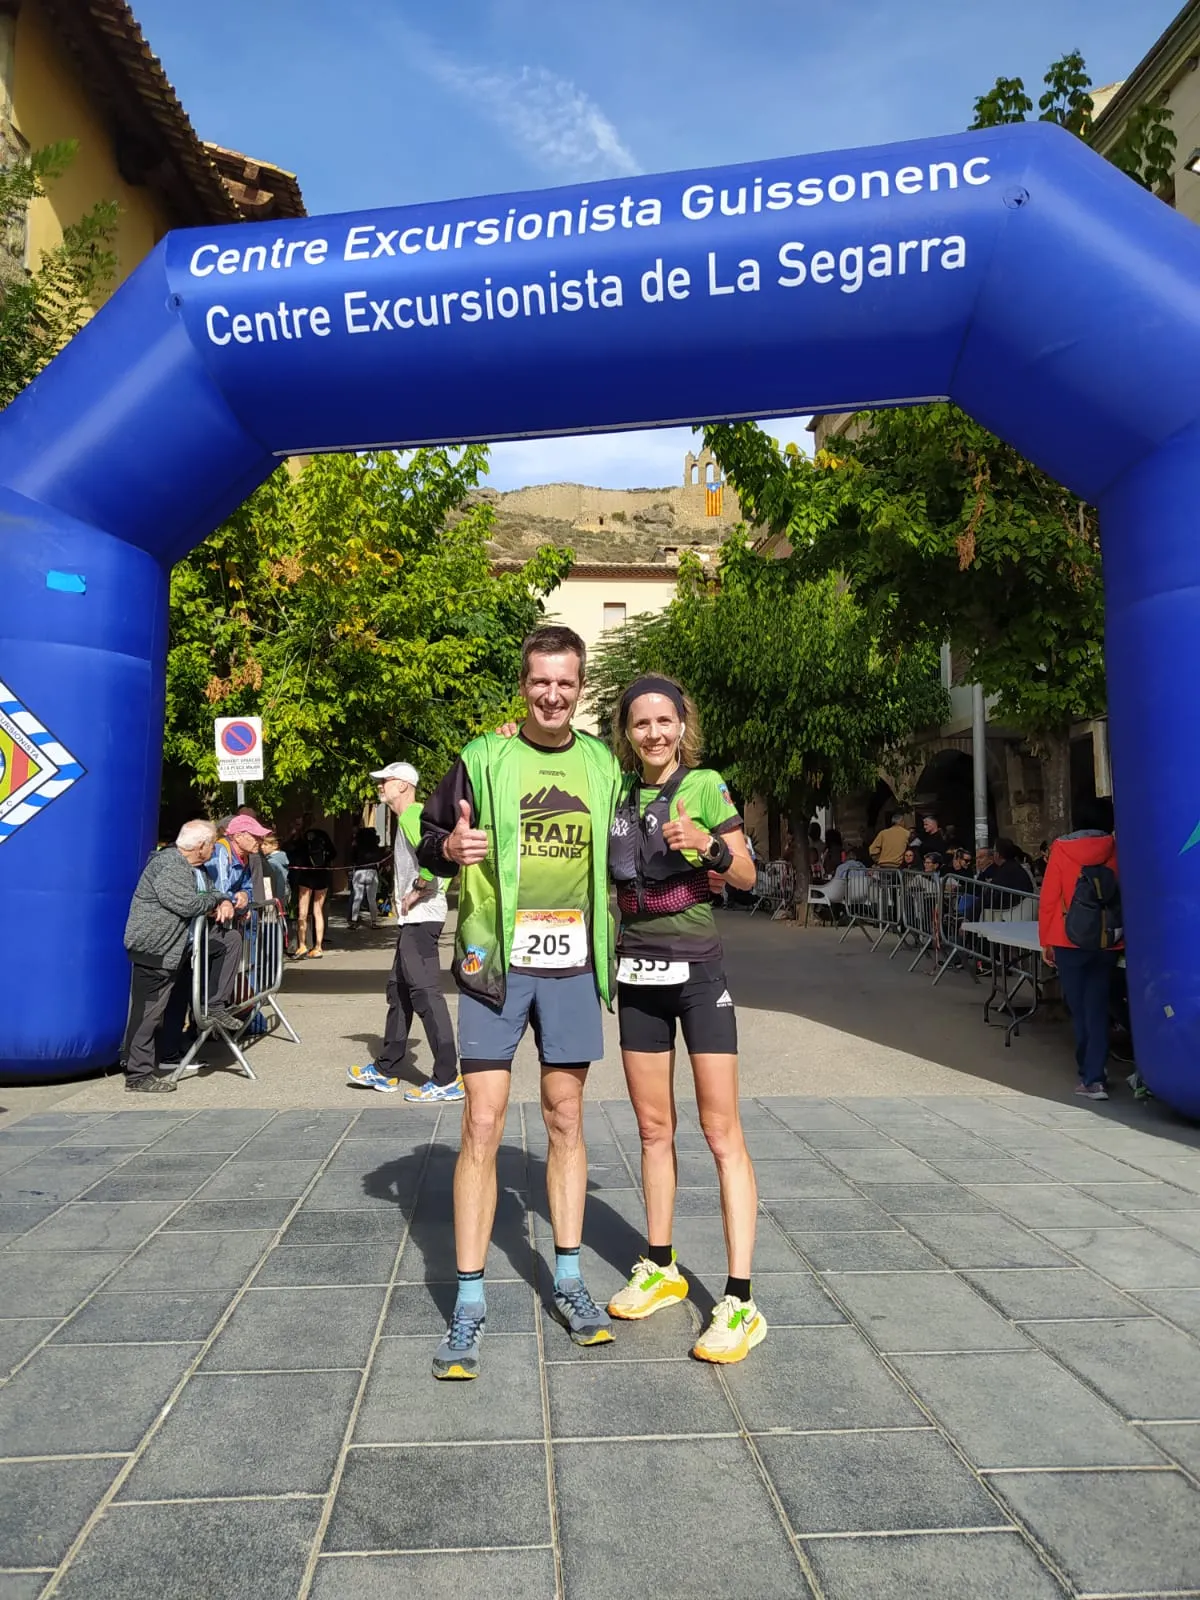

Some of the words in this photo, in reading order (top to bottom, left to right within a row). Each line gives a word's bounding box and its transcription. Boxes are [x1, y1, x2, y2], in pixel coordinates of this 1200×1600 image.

[189, 238, 329, 277] Centre
[343, 194, 662, 261] Excursionista
[682, 156, 991, 220] Guissonenc
[206, 302, 331, 345] Centre
[344, 269, 623, 333] Excursionista
[641, 258, 690, 303] de
[708, 252, 760, 296] La
[778, 235, 967, 294] Segarra
[0, 714, 39, 760] URSIONISTA
[520, 822, 587, 846] RAIL
[527, 934, 571, 956] 205
